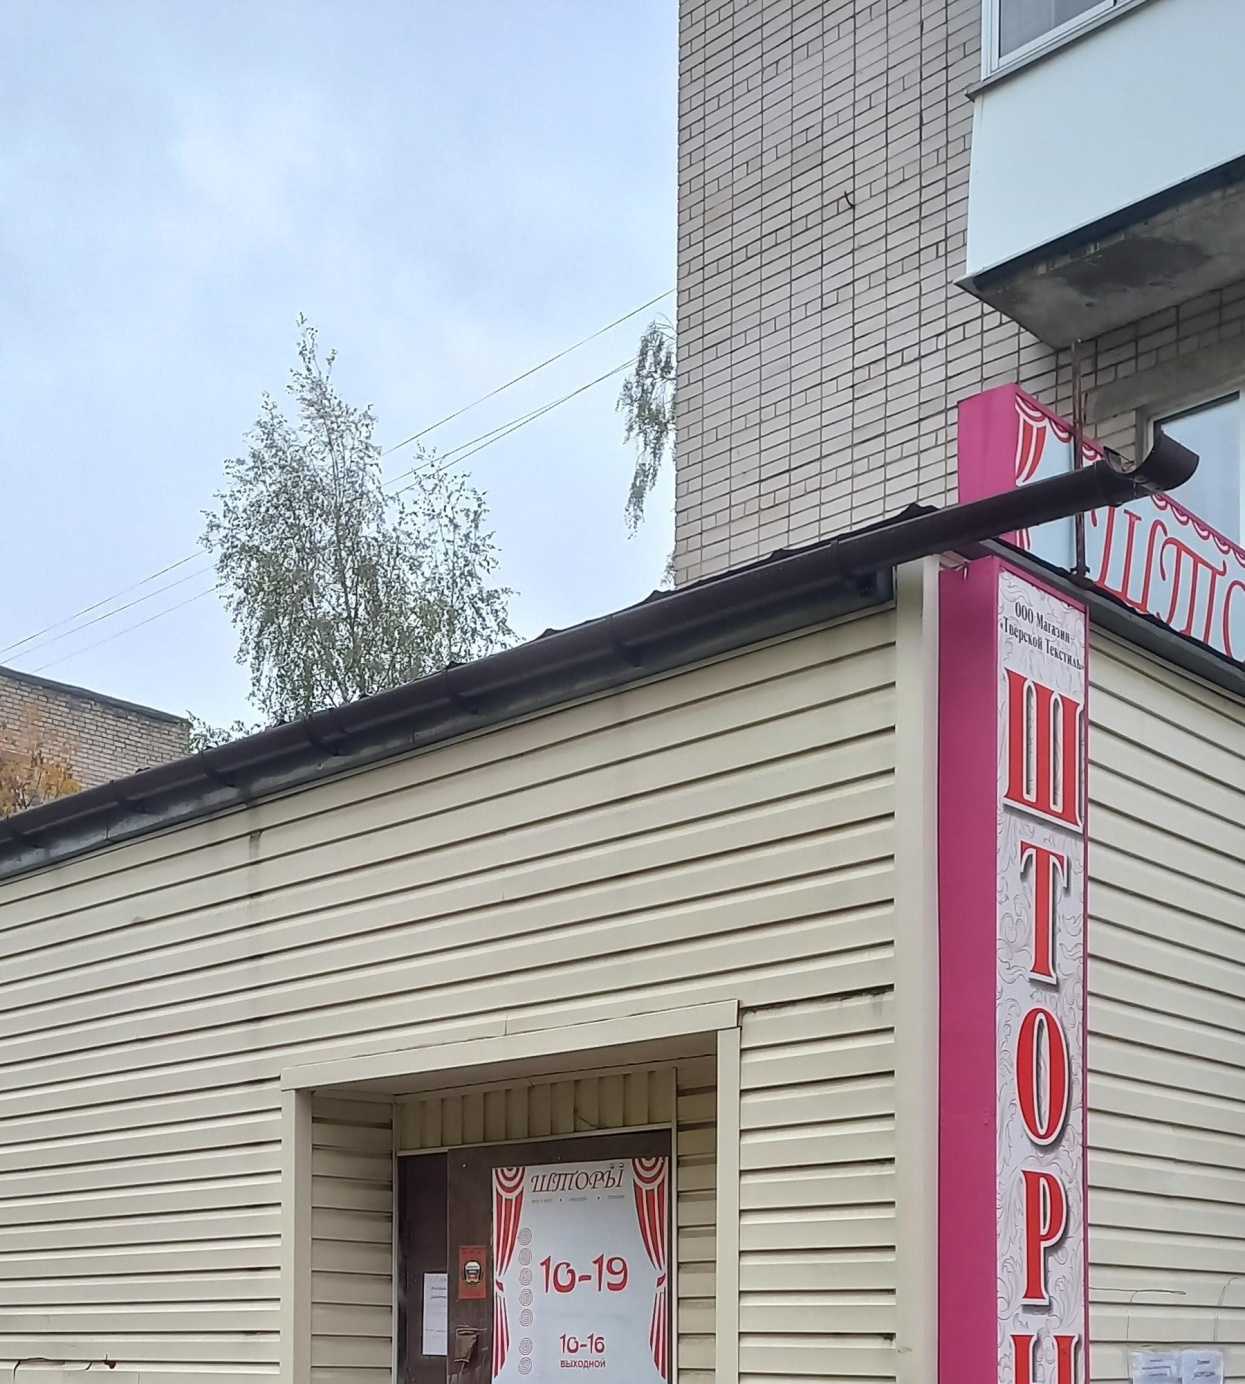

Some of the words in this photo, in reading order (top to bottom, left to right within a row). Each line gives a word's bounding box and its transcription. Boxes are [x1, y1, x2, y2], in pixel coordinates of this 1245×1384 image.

[1015, 601, 1034, 624] ООО
[1036, 611, 1070, 644] Магазин
[530, 1162, 625, 1193] ШТОРЫ
[539, 1253, 629, 1294] 10-19
[559, 1332, 606, 1354] 10-16
[559, 1359, 607, 1369] ВЫХОДНОЙ
